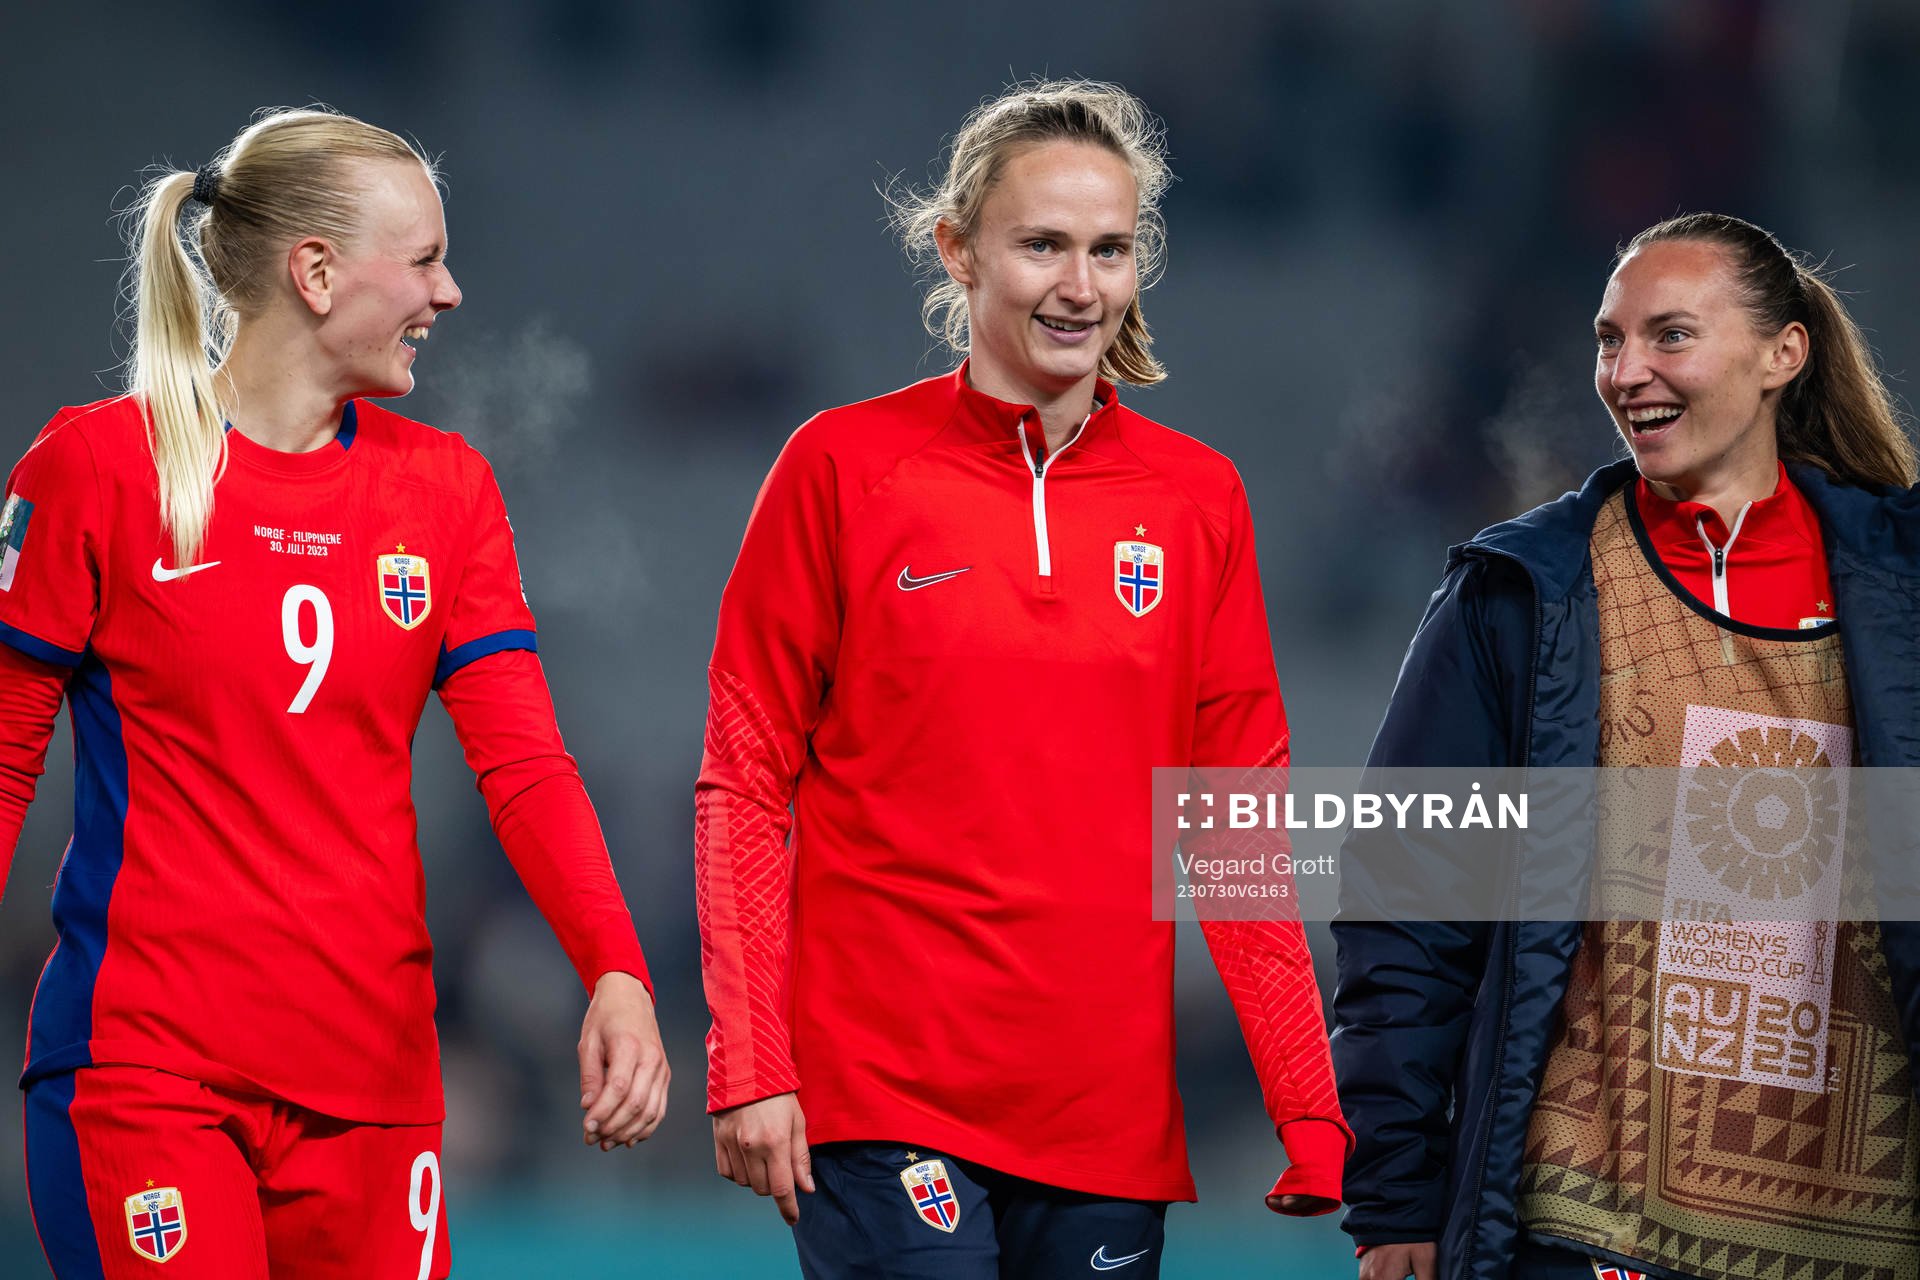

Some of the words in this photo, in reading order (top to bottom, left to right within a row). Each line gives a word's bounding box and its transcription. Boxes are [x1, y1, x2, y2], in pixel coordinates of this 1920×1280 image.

[254, 525, 285, 540] NORGE
[293, 531, 342, 544] FILIPPINENE
[270, 541, 284, 553] 30.
[286, 543, 305, 555] JULI
[307, 545, 328, 556] 2023
[281, 584, 334, 713] 9
[1672, 898, 1733, 926] FIFA
[1671, 921, 1790, 956] WOMEN'S
[1668, 945, 1756, 974] WORLD
[1761, 958, 1806, 980] CUP
[1664, 982, 1742, 1027] AU
[1756, 994, 1822, 1039] 20
[1661, 1022, 1737, 1068] NZ
[1752, 1034, 1818, 1080] 23
[143, 1191, 160, 1201] NORGE
[408, 1151, 441, 1280] 9
